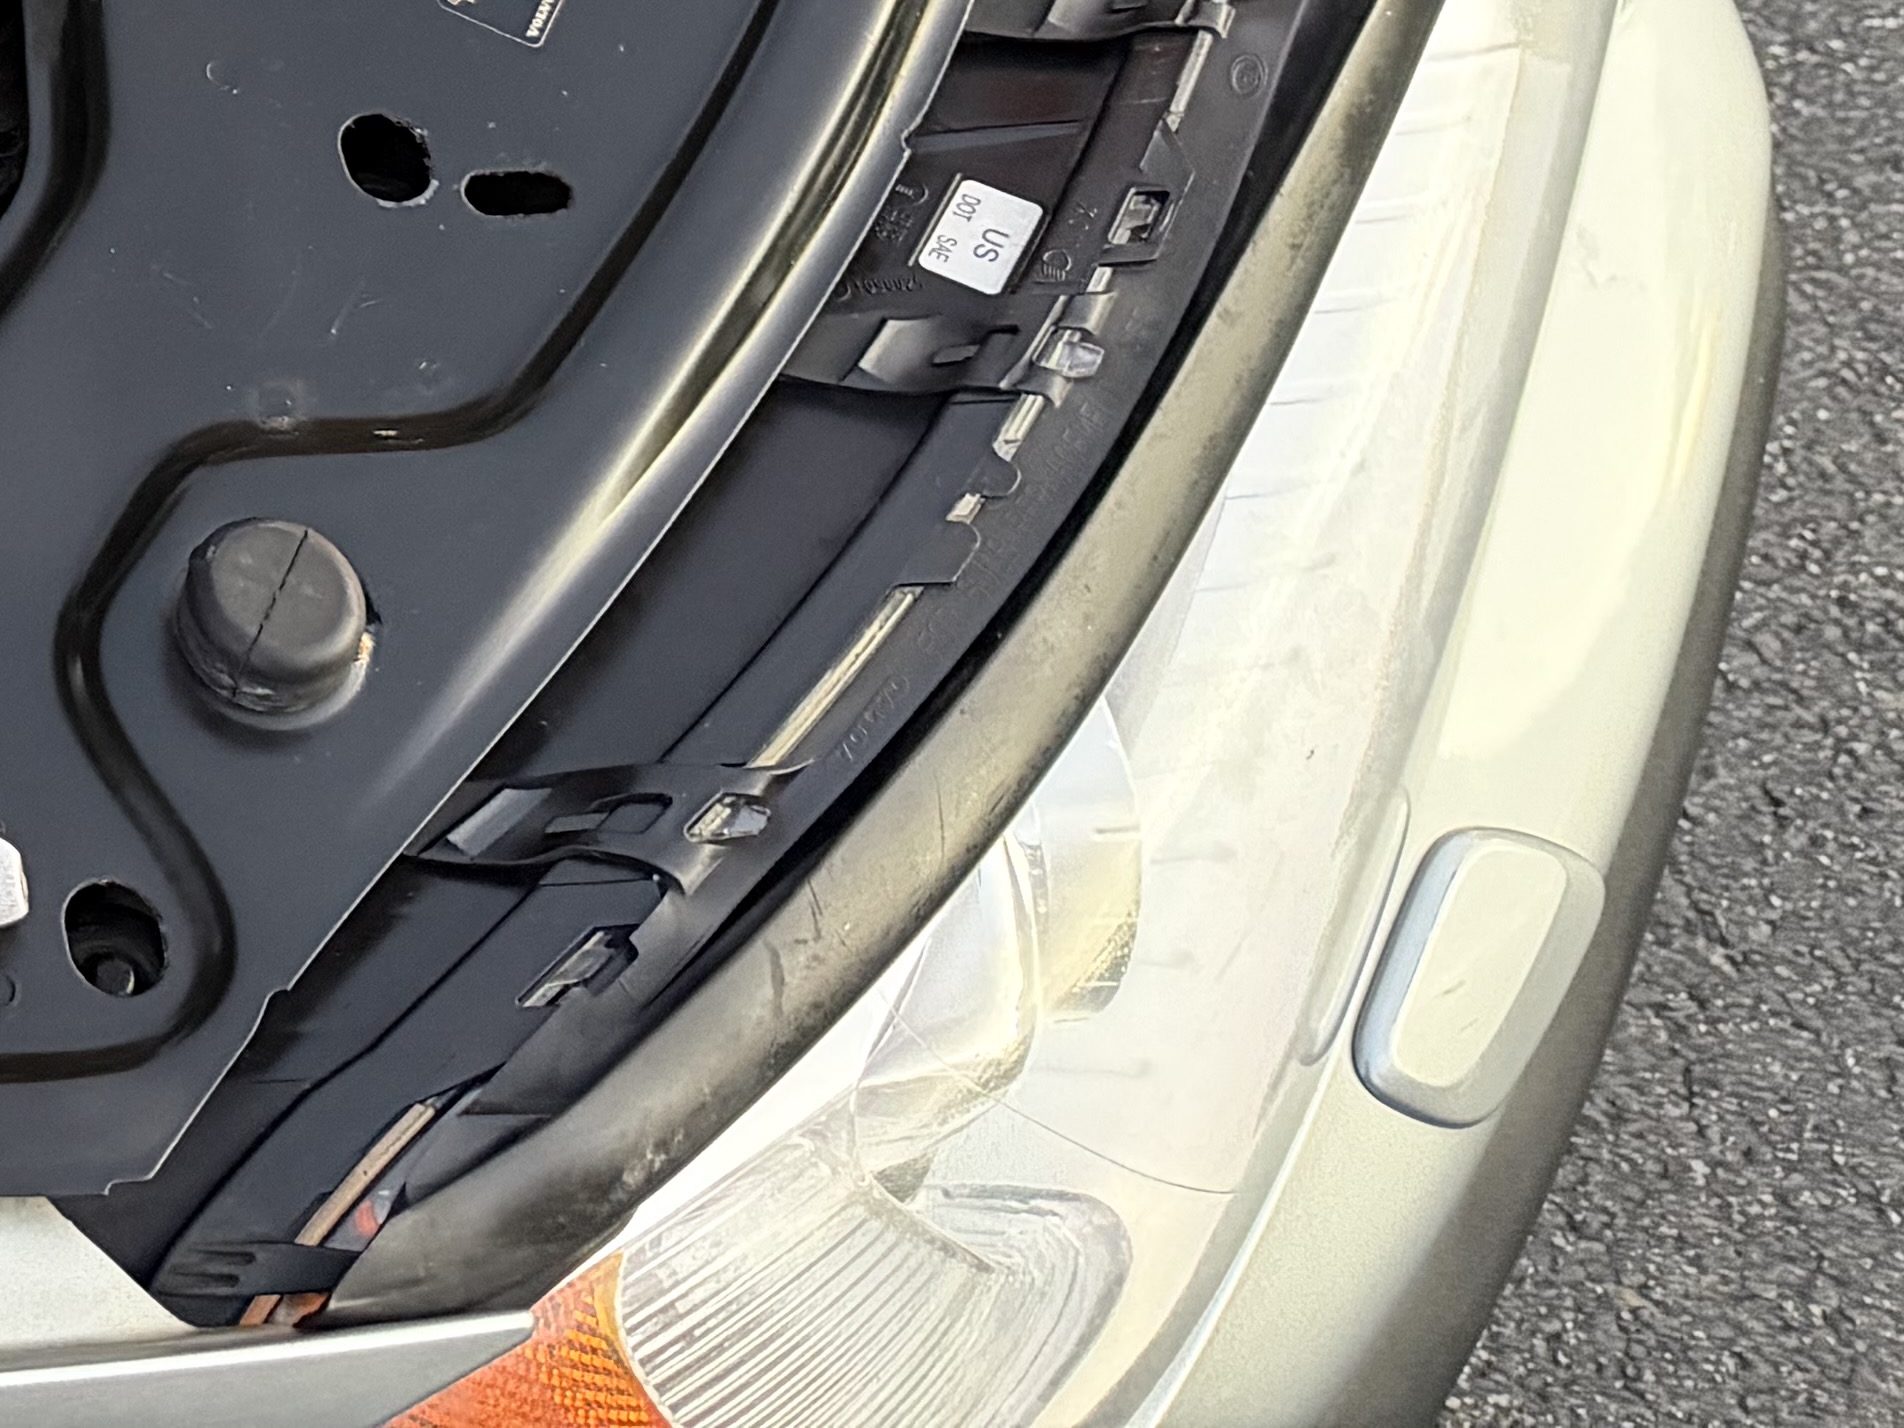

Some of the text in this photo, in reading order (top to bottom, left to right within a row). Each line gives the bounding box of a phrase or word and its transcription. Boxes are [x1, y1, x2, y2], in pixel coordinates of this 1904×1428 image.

[928, 194, 982, 263] DOT SAE
[973, 228, 1010, 263] US
